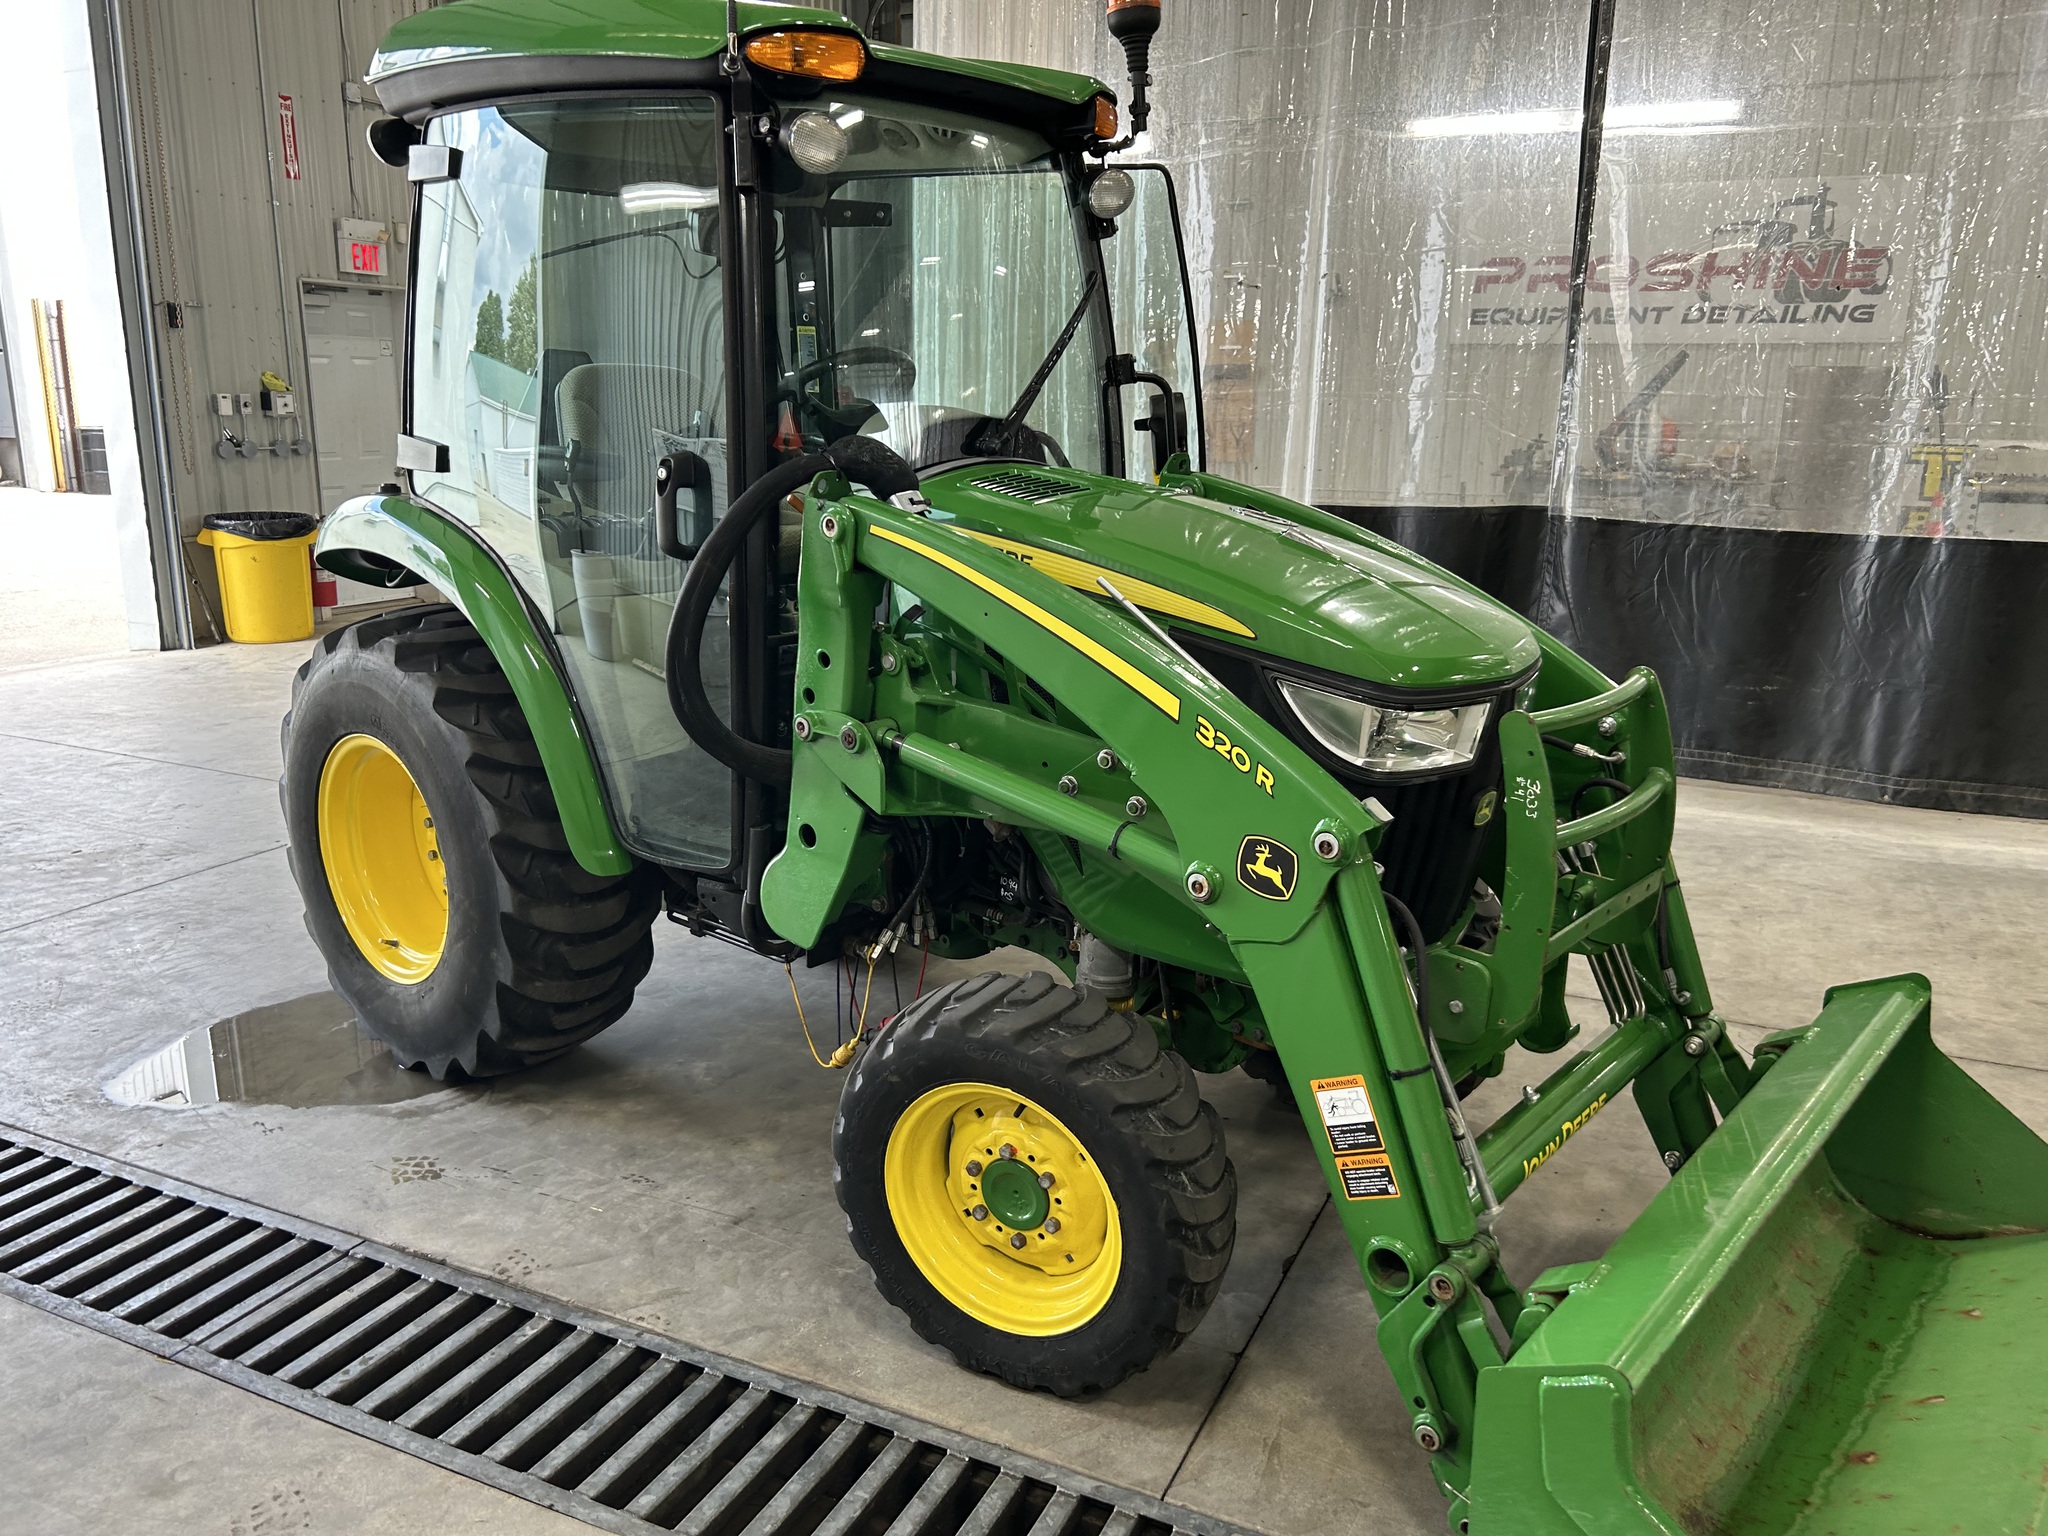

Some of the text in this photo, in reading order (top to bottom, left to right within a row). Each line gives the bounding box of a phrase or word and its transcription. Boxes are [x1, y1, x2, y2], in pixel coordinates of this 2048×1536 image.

[280, 102, 292, 112] FIRE
[352, 243, 379, 272] EXIT
[1473, 249, 1890, 293] PROSHINE
[1470, 303, 1878, 326] EQUIPMENT DETAILING
[1194, 714, 1275, 799] 320 R
[1325, 1078, 1359, 1089] WARNING
[1523, 1092, 1608, 1180] JOHN DEERE
[1350, 1158, 1384, 1166] WARNING
